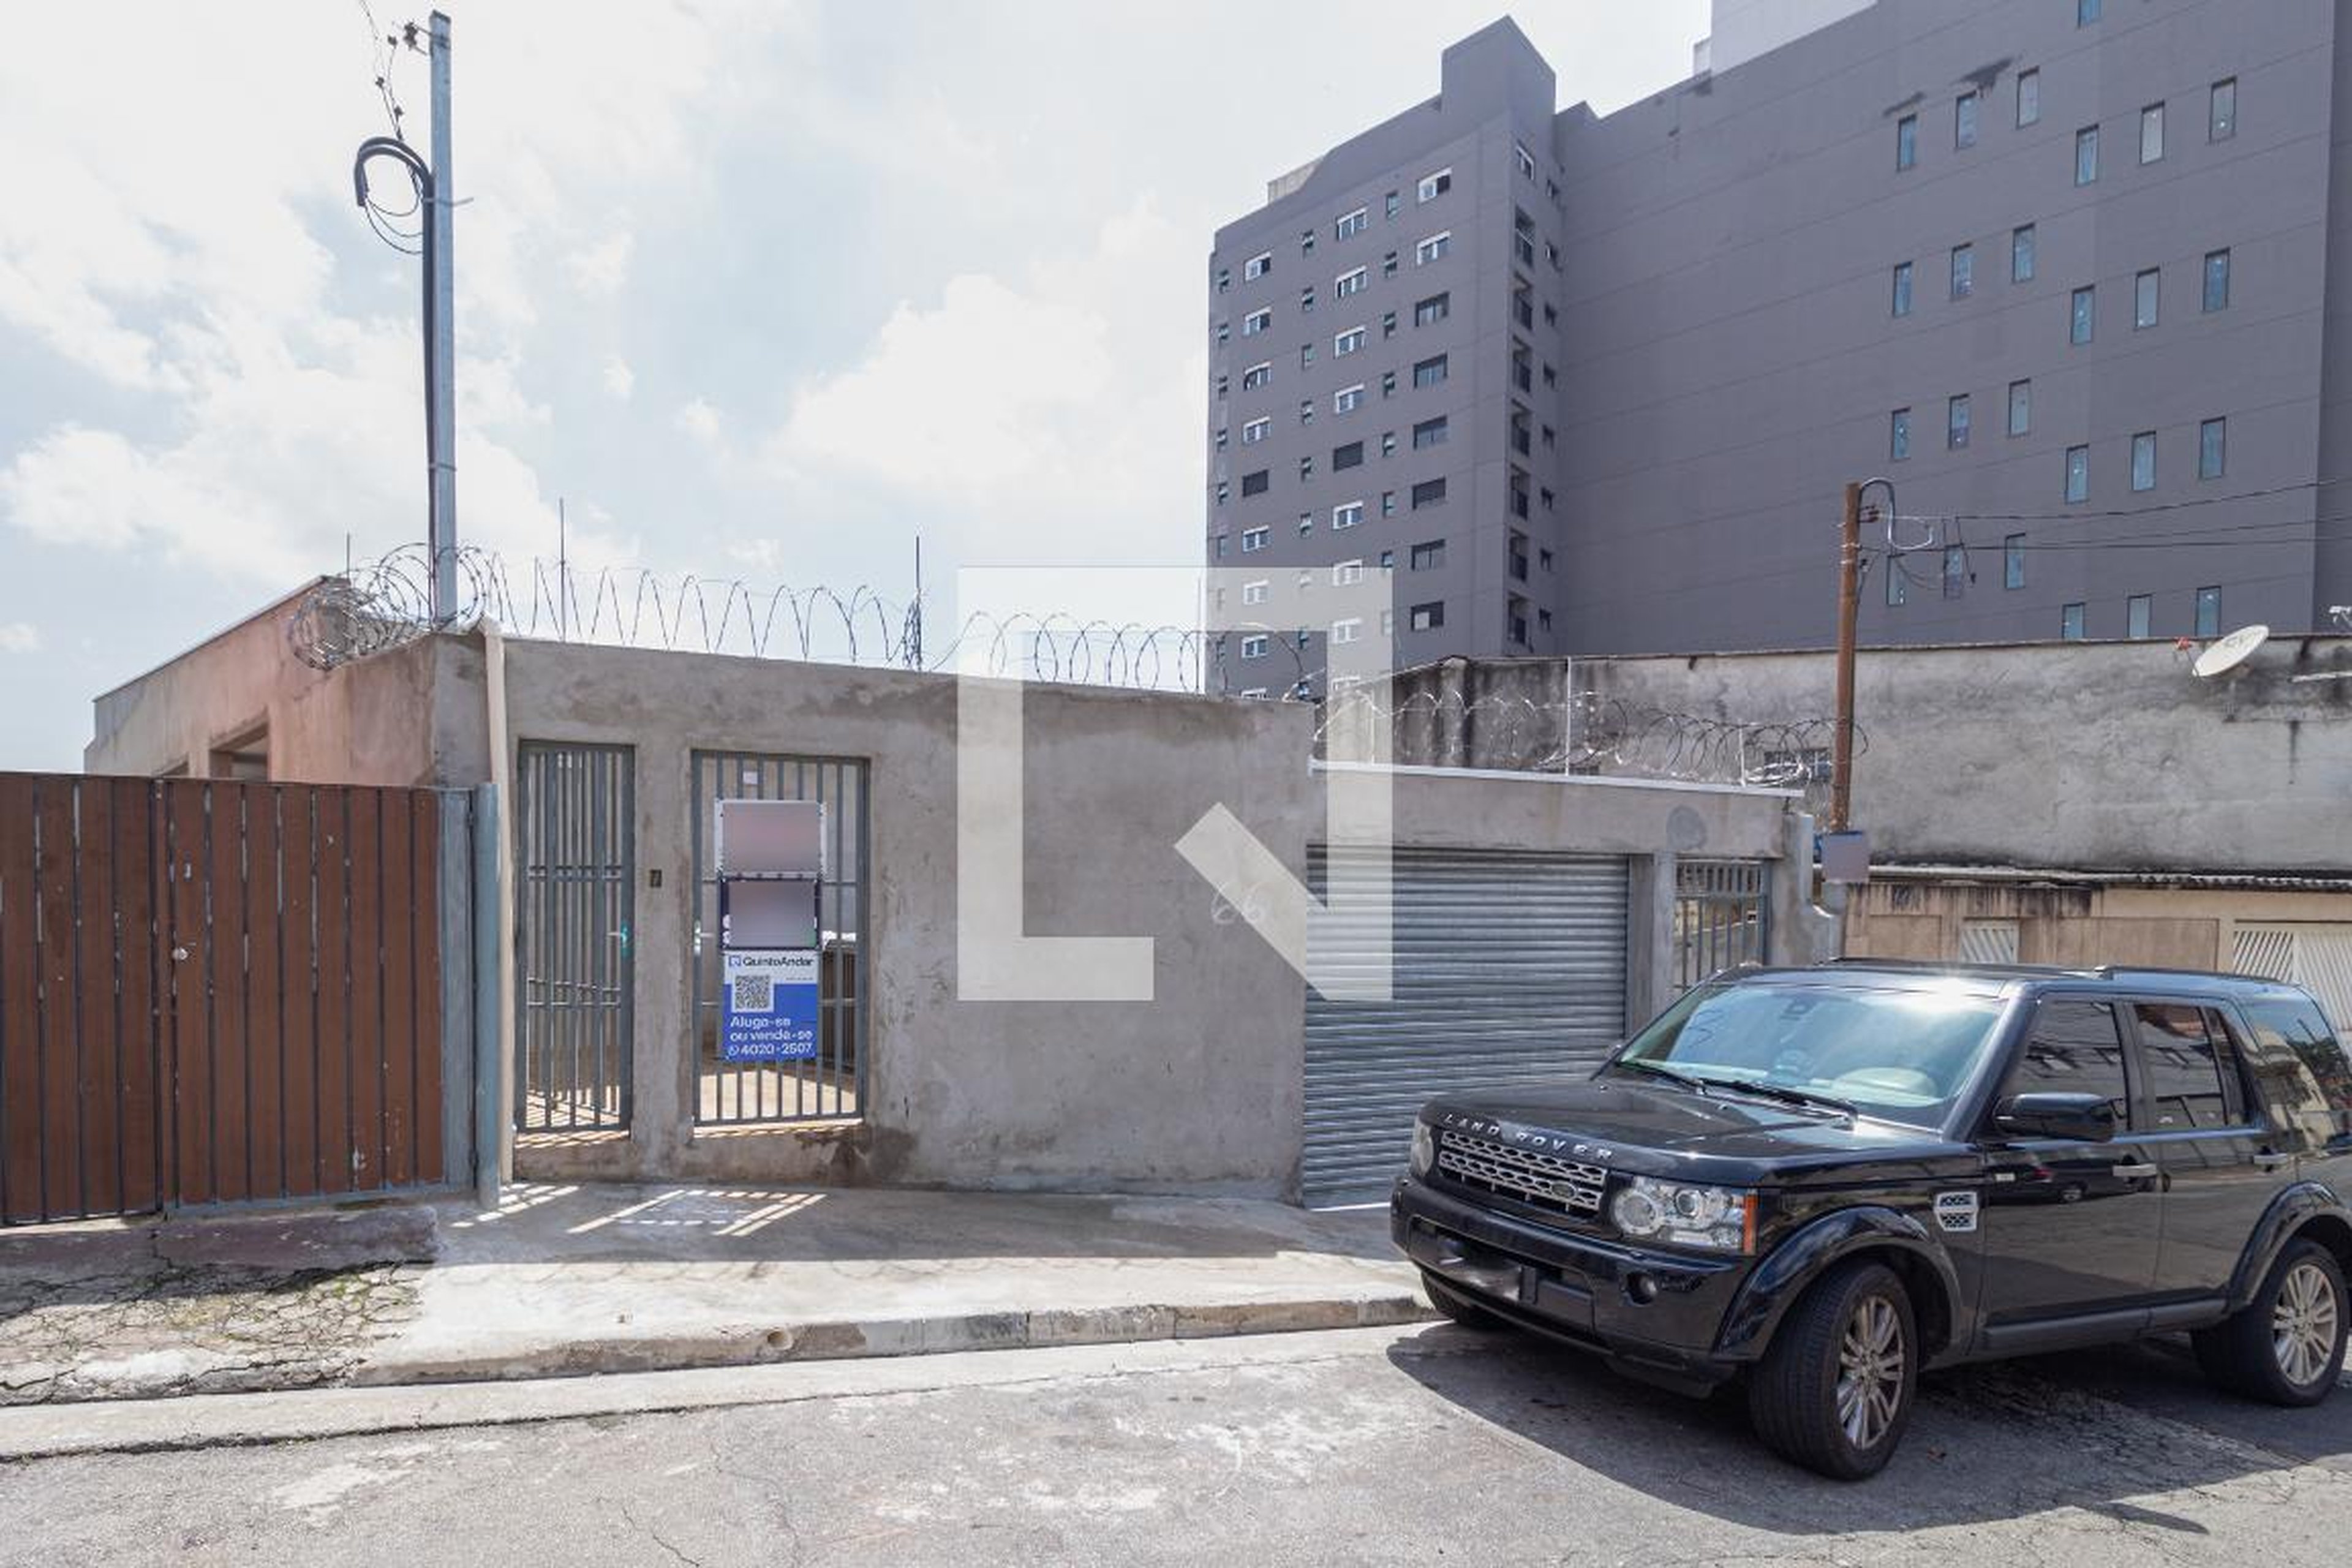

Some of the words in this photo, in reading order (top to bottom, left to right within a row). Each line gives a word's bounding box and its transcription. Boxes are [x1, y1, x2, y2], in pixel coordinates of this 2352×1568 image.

[743, 957, 813, 967] QuintoAndar
[730, 1032, 748, 1041] ou
[1444, 1114, 1500, 1134] LAND
[1517, 1132, 1612, 1160] ROVER
